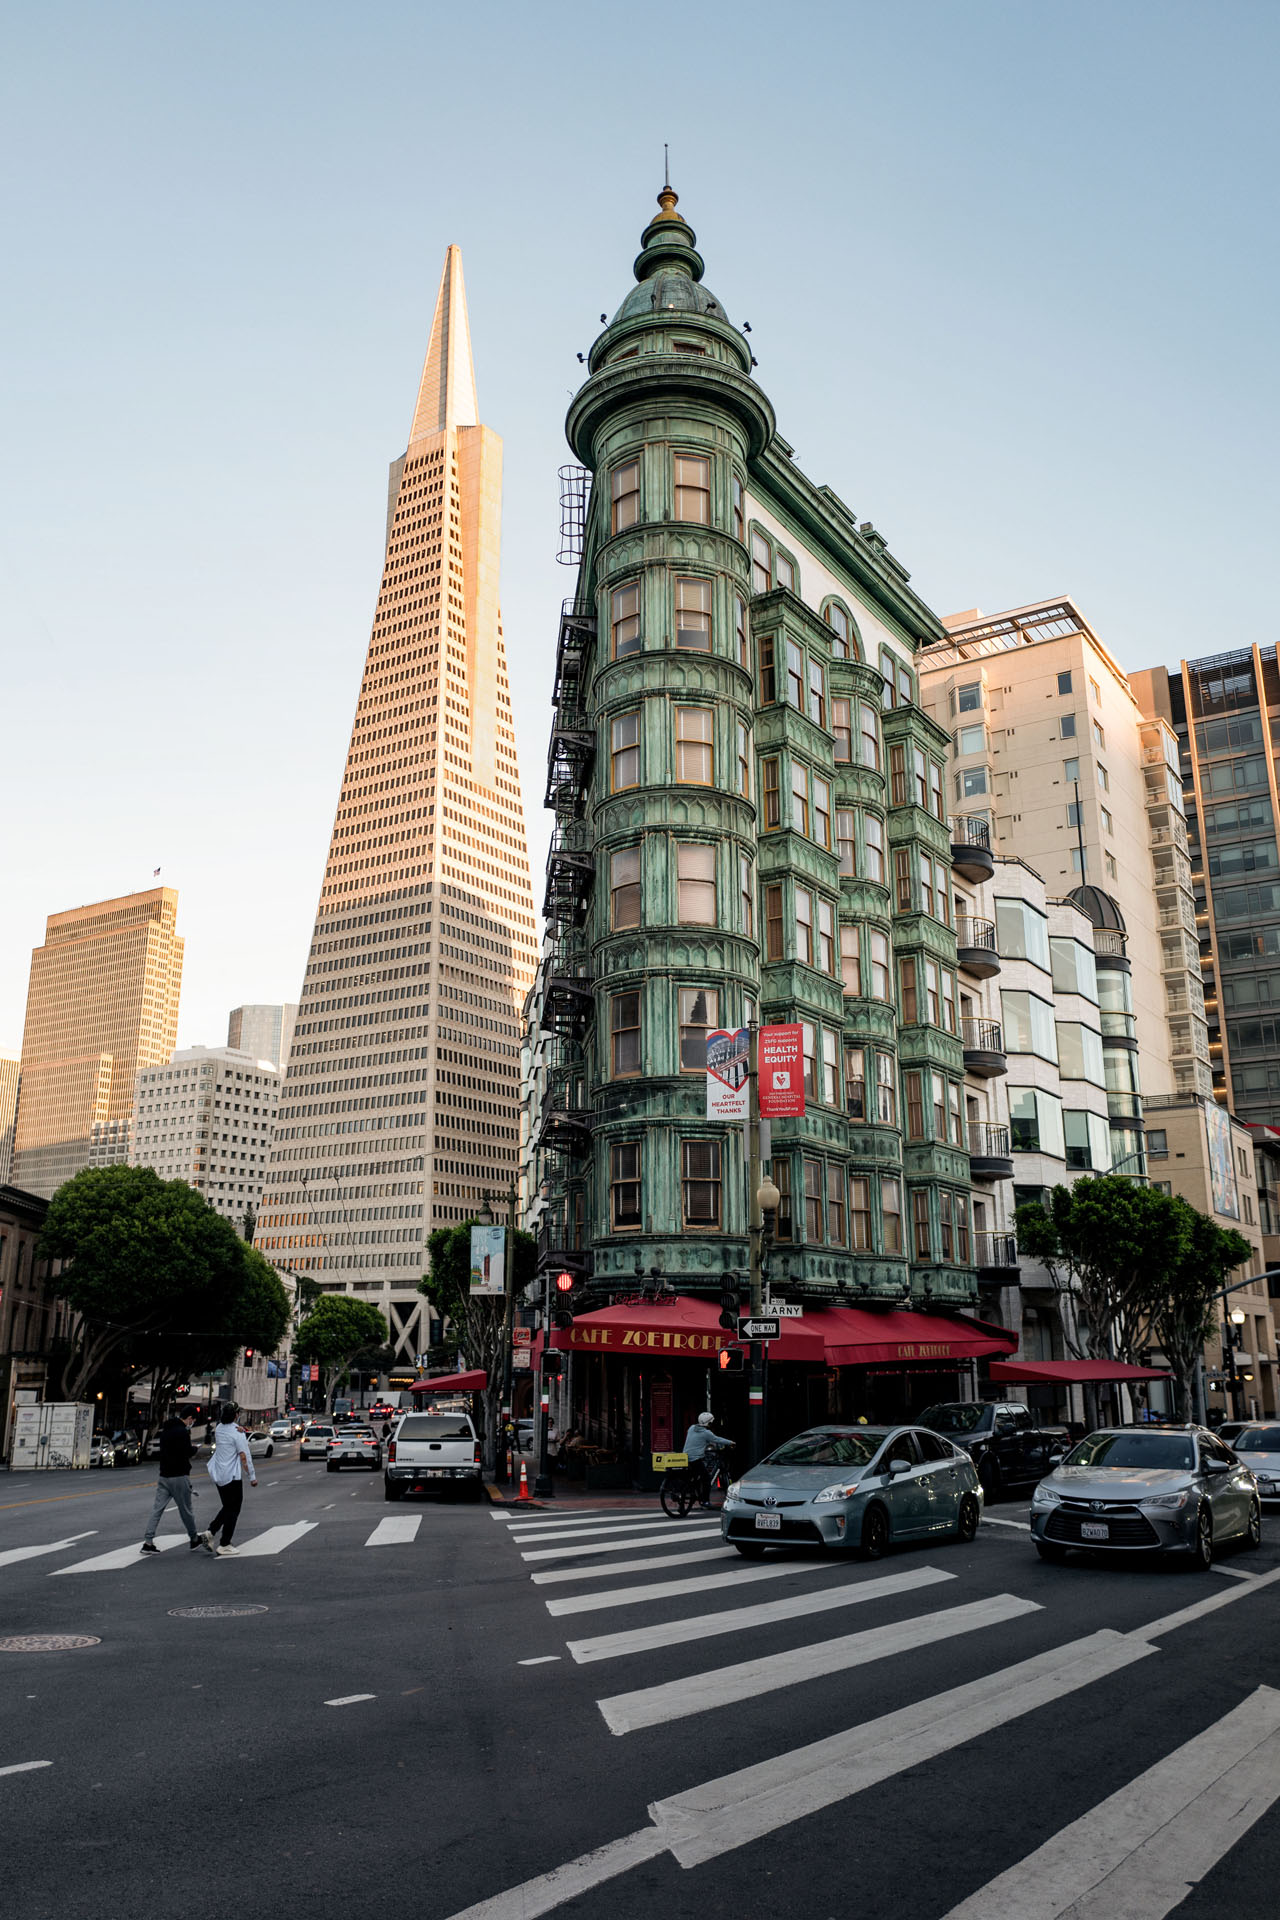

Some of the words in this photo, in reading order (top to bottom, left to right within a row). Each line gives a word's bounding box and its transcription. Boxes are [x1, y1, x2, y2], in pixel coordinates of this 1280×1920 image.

[763, 1045, 798, 1054] HEALTH
[764, 1055, 798, 1063] EQUITY
[761, 1306, 800, 1315] ARNY
[750, 1324, 762, 1332] ONE
[764, 1324, 775, 1332] WAY
[570, 1327, 613, 1345] CAFE
[622, 1330, 727, 1351] ZOETROPE
[897, 1345, 915, 1358] CAFE
